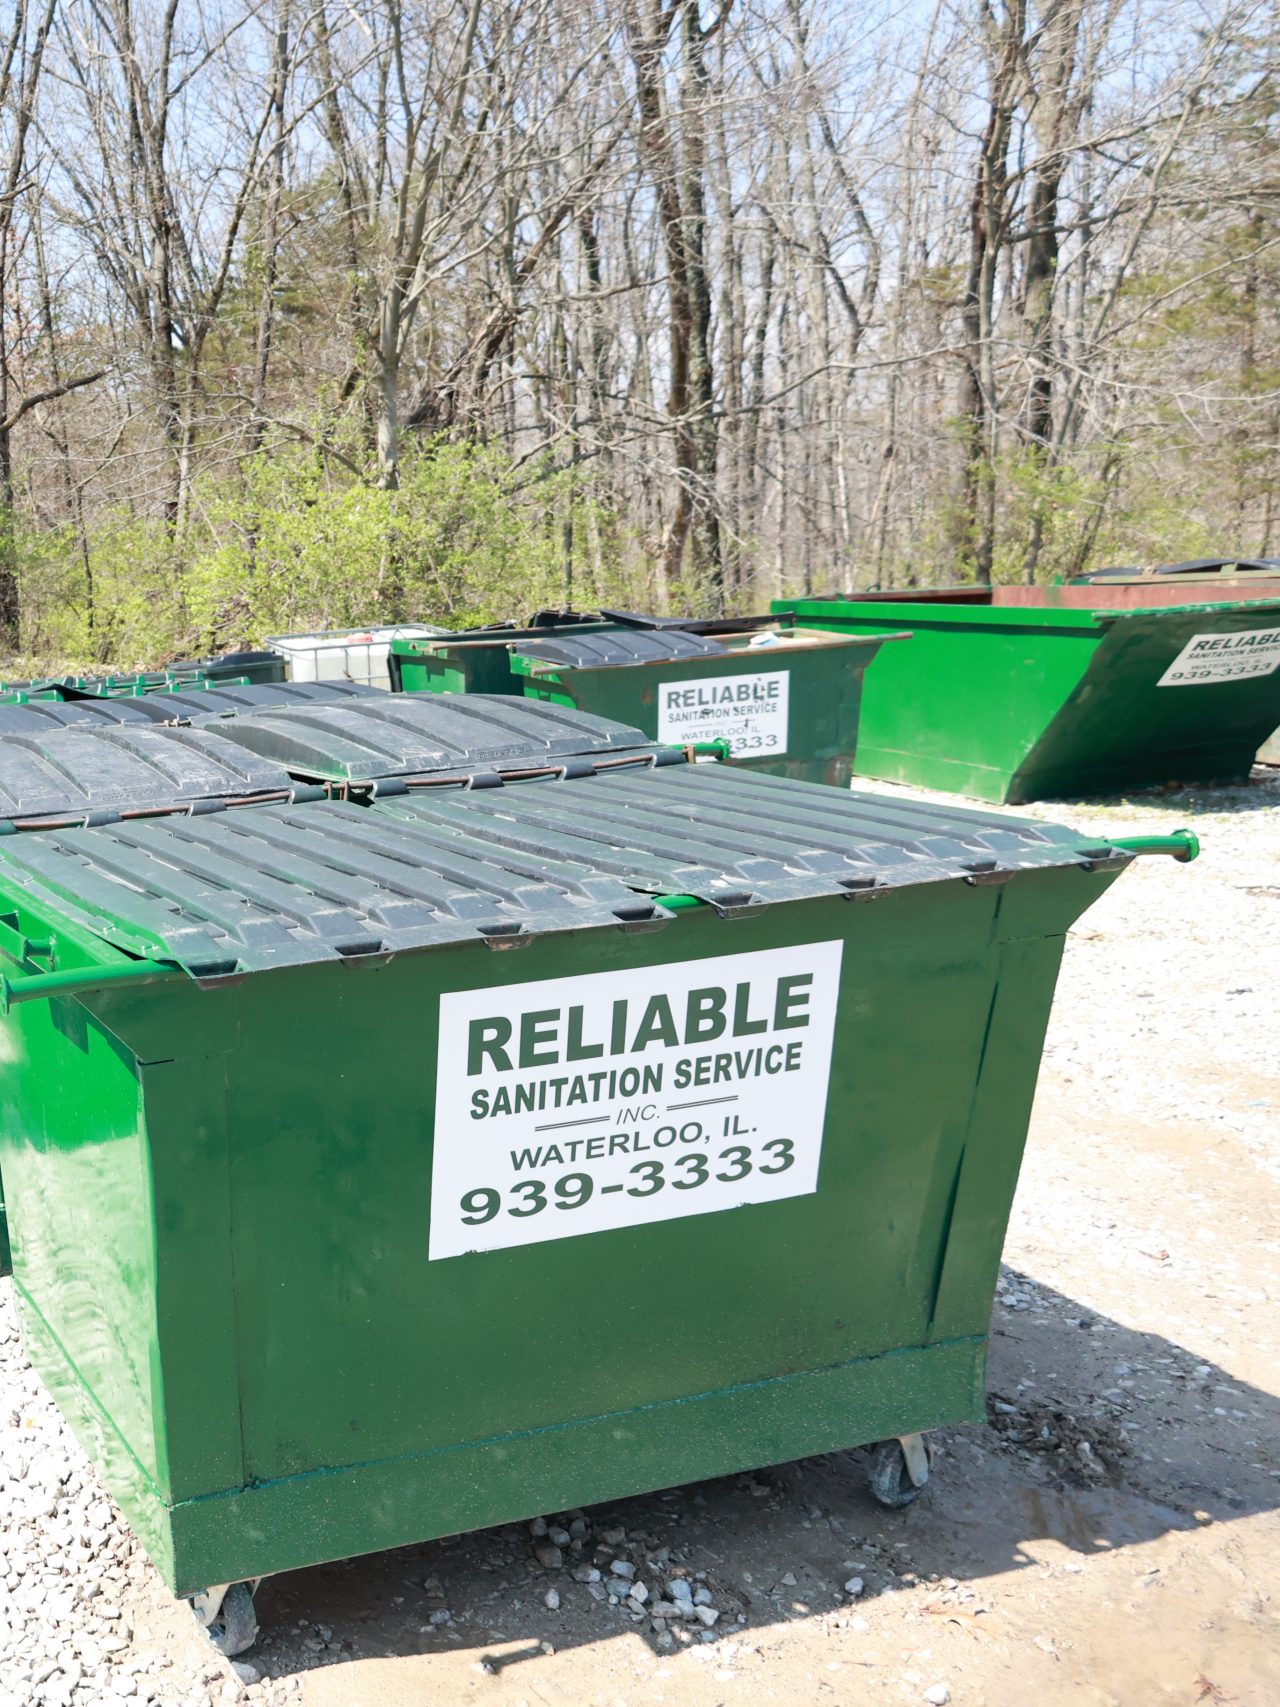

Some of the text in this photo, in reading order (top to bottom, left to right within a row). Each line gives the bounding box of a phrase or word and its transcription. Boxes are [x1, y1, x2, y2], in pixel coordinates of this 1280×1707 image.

[1187, 649, 1246, 660] SANITATION
[1170, 662, 1272, 680] 939-3333
[667, 680, 780, 709] RELIABLE
[668, 702, 778, 723] SANITATION SERVICE
[466, 972, 814, 1077] RELIABLE
[470, 1041, 803, 1120] SANITATION SERVICE
[616, 1103, 660, 1125] INC.
[510, 1114, 757, 1171] WATERLOO, IL.
[460, 1137, 795, 1226] 939-3333
